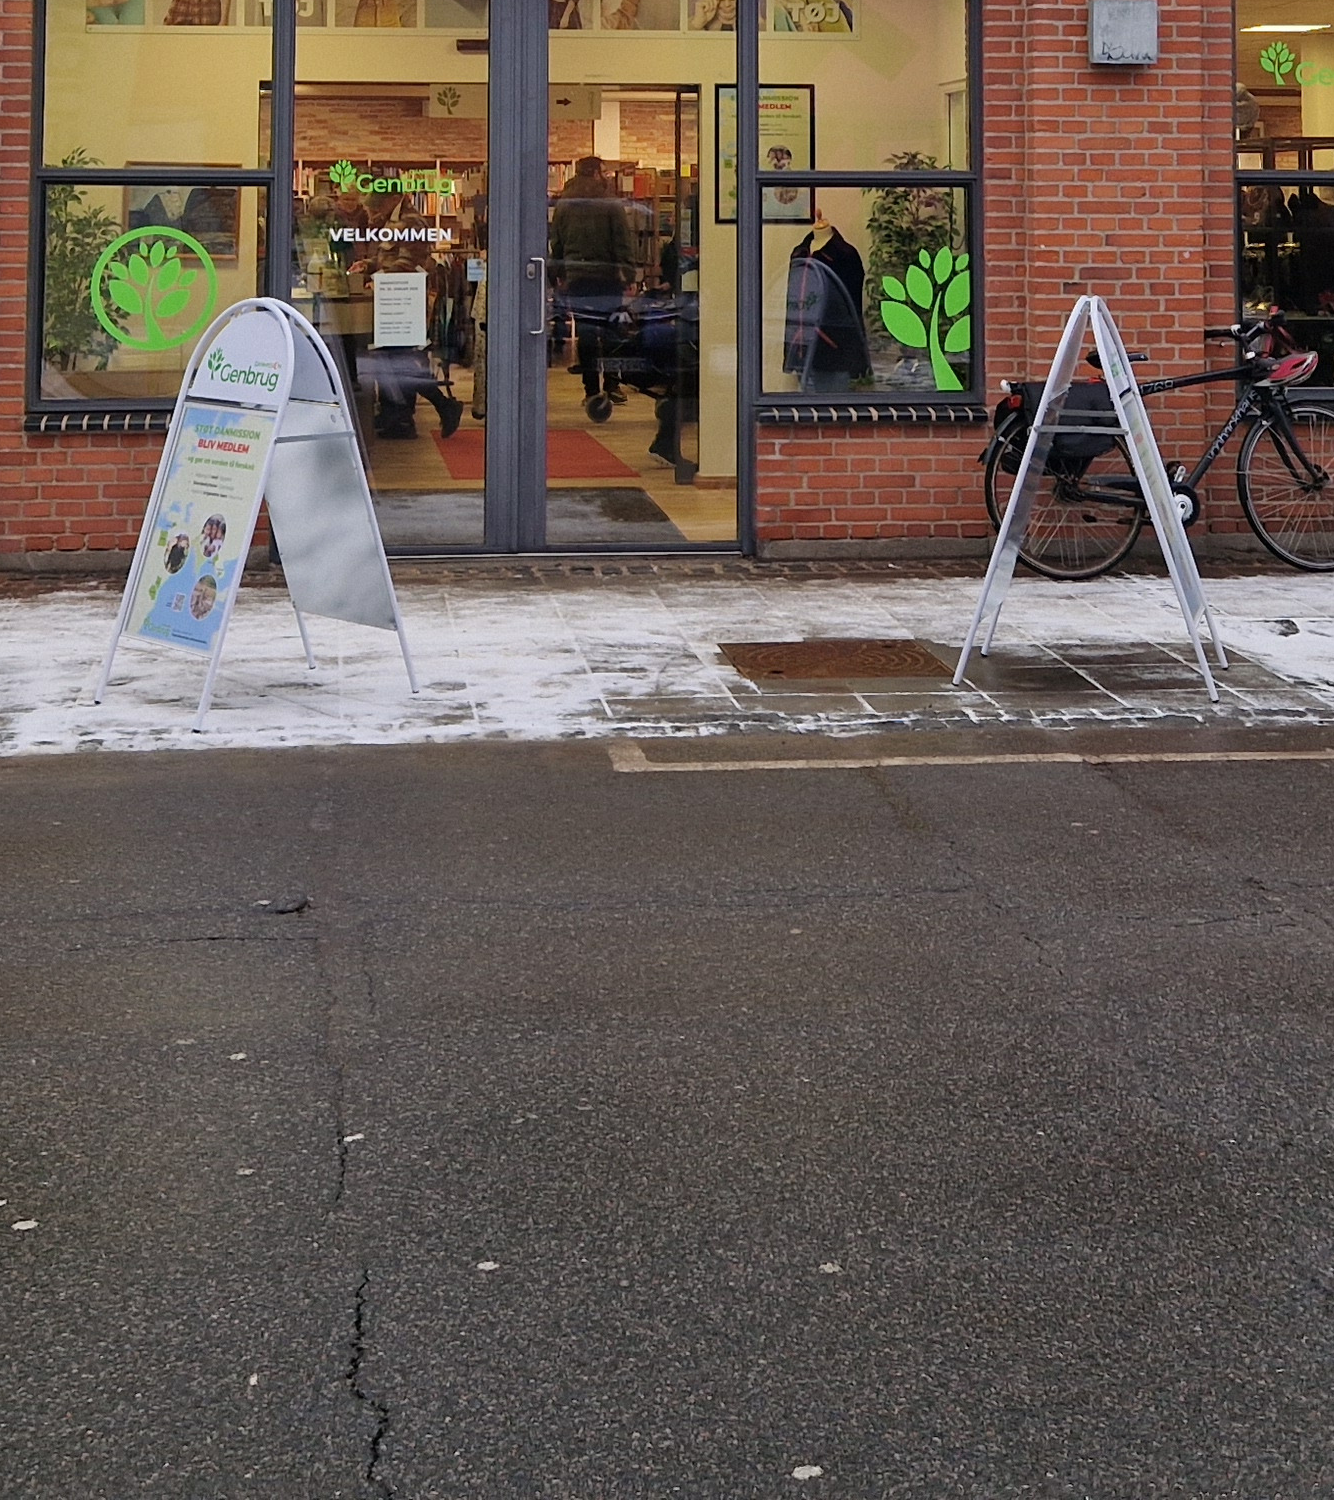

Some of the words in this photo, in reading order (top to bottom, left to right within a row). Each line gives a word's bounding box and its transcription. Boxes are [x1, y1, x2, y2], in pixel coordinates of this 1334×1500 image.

[786, 1, 840, 24] TØJ
[356, 174, 453, 197] Genbrug
[329, 228, 452, 242] VELKOMMEN
[220, 363, 280, 392] Genbrug
[197, 438, 216, 450] BLIV
[216, 440, 250, 454] MEDLEM
